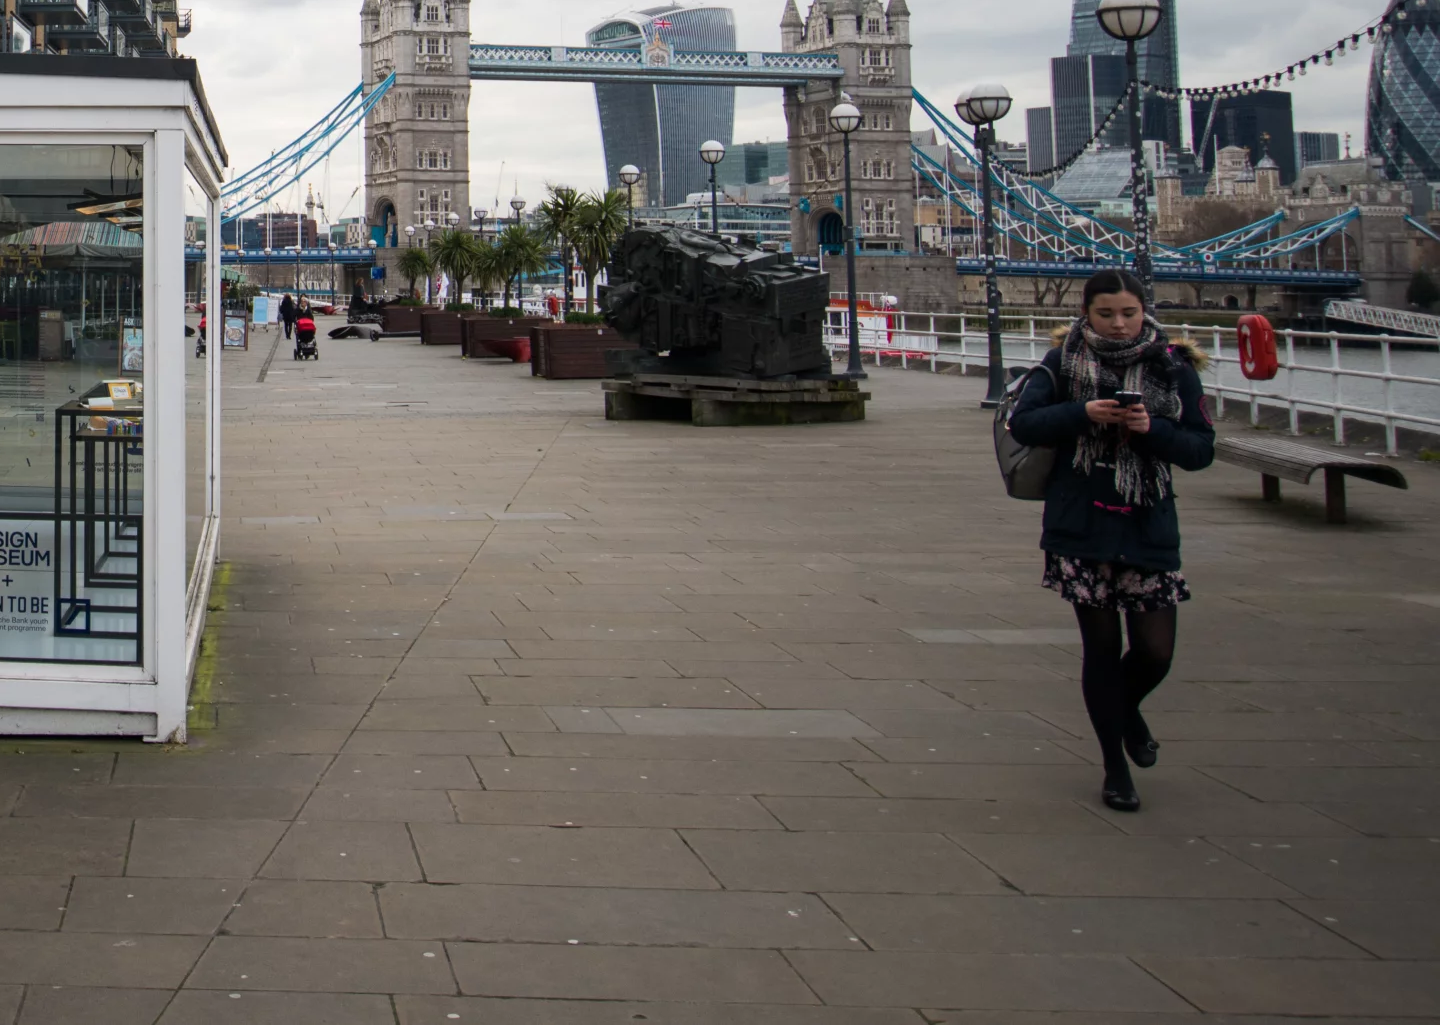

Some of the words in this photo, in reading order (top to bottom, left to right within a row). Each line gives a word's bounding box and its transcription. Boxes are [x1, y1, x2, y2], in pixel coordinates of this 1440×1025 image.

[7, 596, 27, 613] TO
[30, 597, 49, 614] BE
[11, 616, 28, 624] Bank
[29, 617, 49, 625] youth
[7, 624, 47, 633] programme
